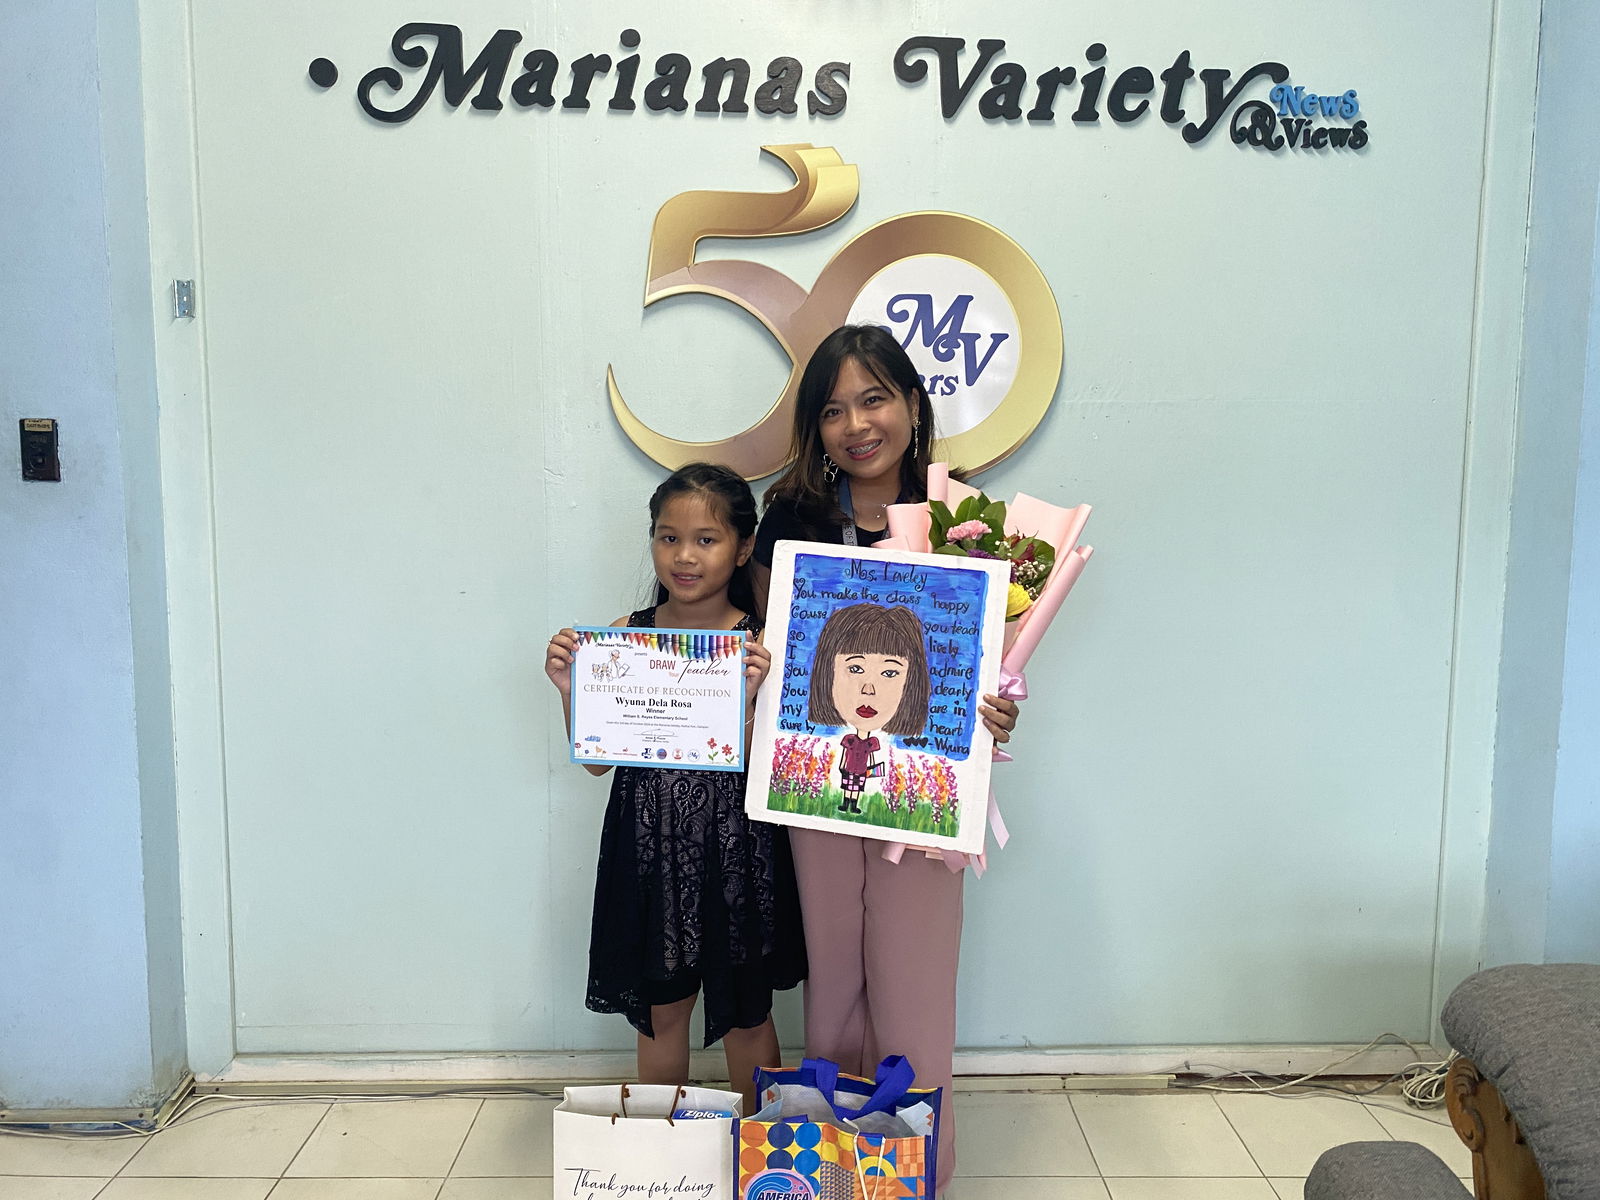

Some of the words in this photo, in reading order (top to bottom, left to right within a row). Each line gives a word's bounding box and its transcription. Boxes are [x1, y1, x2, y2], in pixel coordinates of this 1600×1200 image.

[357, 22, 851, 124] Marianas
[893, 36, 1289, 143] Variety
[1269, 84, 1359, 119] News
[886, 294, 1009, 387] MV
[793, 578, 816, 600] You
[821, 587, 858, 600] make
[860, 586, 880, 602] the
[885, 590, 922, 605] class
[931, 592, 970, 615] happy
[923, 621, 949, 635] you
[951, 620, 980, 637] teach
[789, 630, 806, 642] so
[929, 636, 959, 659] lively
[649, 659, 676, 670] DRAW
[678, 658, 730, 683] Teacher
[787, 641, 797, 660] I
[930, 658, 974, 680] admire
[583, 684, 644, 695] CERTIFICATE
[647, 686, 660, 695] OF
[662, 687, 731, 698] RECOGNITION
[615, 697, 646, 708] Wyuna
[648, 698, 668, 708] Dela
[670, 699, 692, 709] Rosa
[934, 679, 974, 702] dearly
[781, 703, 802, 717] my
[928, 715, 963, 737] heart
[929, 704, 948, 714] are
[953, 700, 967, 717] in
[564, 1168, 619, 1196] Thank
[616, 1182, 646, 1198] you
[647, 1181, 671, 1198] for
[673, 1175, 716, 1198] doing
